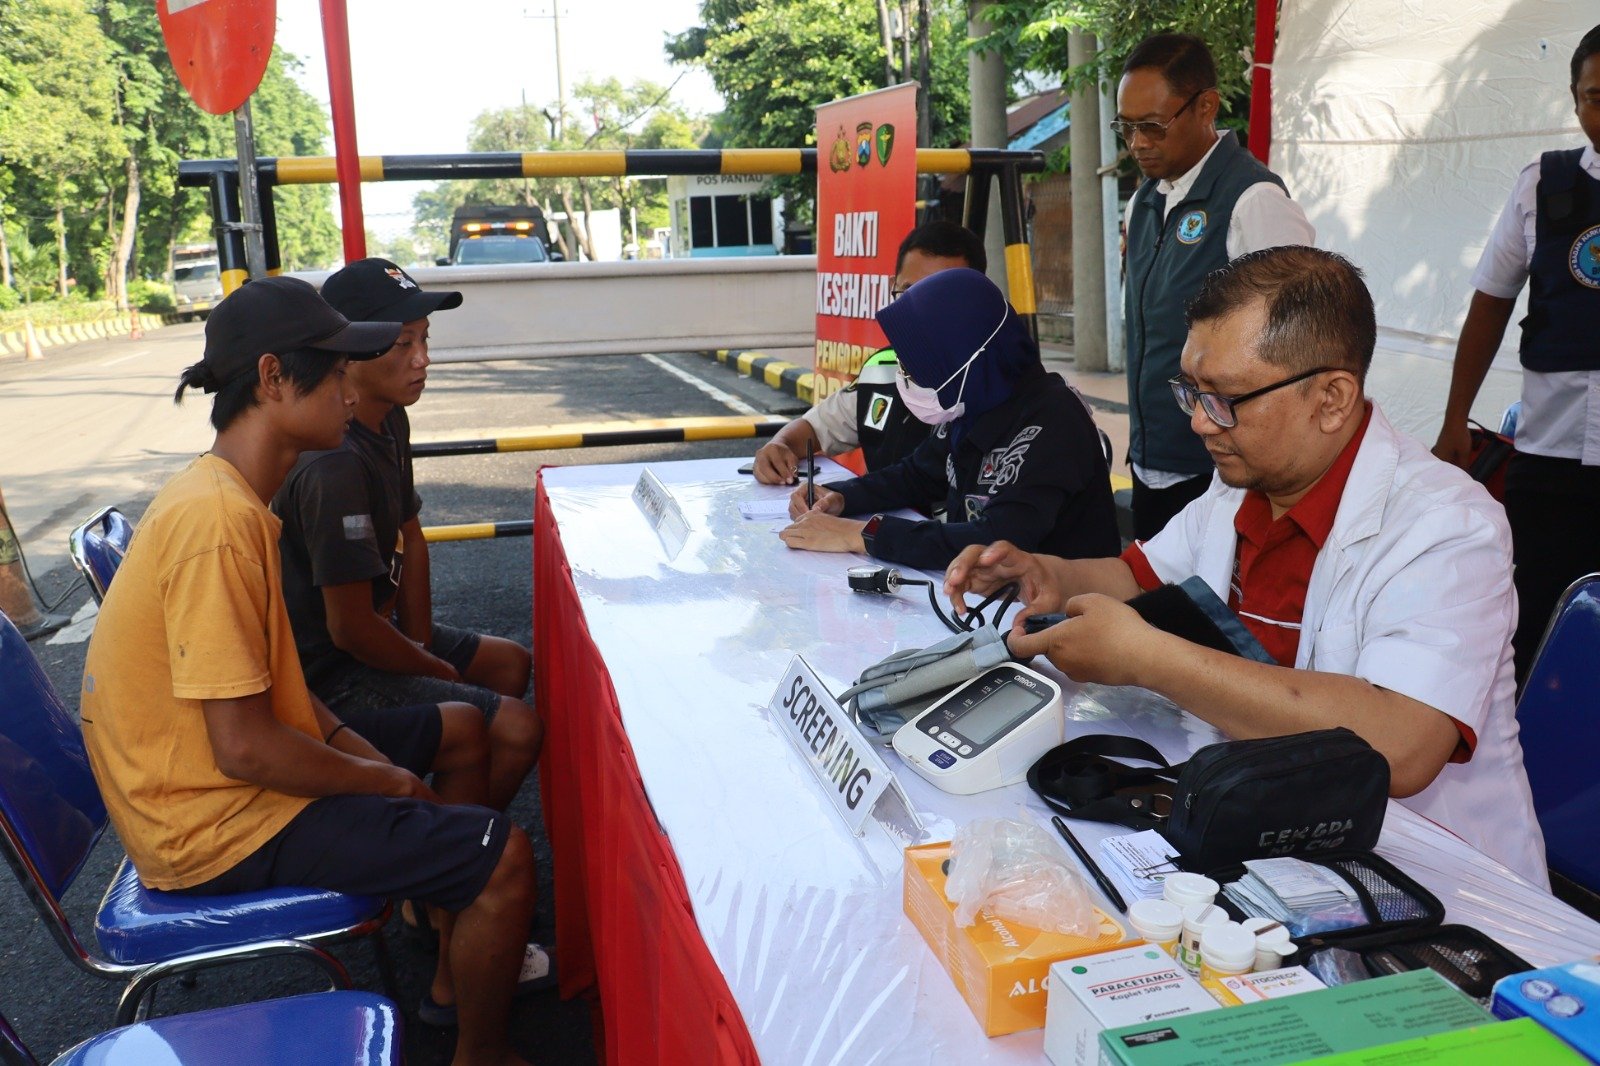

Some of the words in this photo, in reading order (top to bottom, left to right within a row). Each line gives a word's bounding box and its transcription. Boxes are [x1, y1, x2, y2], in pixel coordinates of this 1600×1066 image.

[697, 175, 718, 185] POS
[721, 174, 763, 184] PANTAU
[834, 211, 878, 257] BAKTI
[816, 339, 880, 376] PENGOB
[782, 675, 872, 811] SCREENING
[987, 919, 1020, 947] Alcohol
[1009, 976, 1050, 998] ALC
[1091, 971, 1182, 996] PARACETAMOL
[1144, 984, 1162, 995] 500
[1164, 982, 1181, 993] mg
